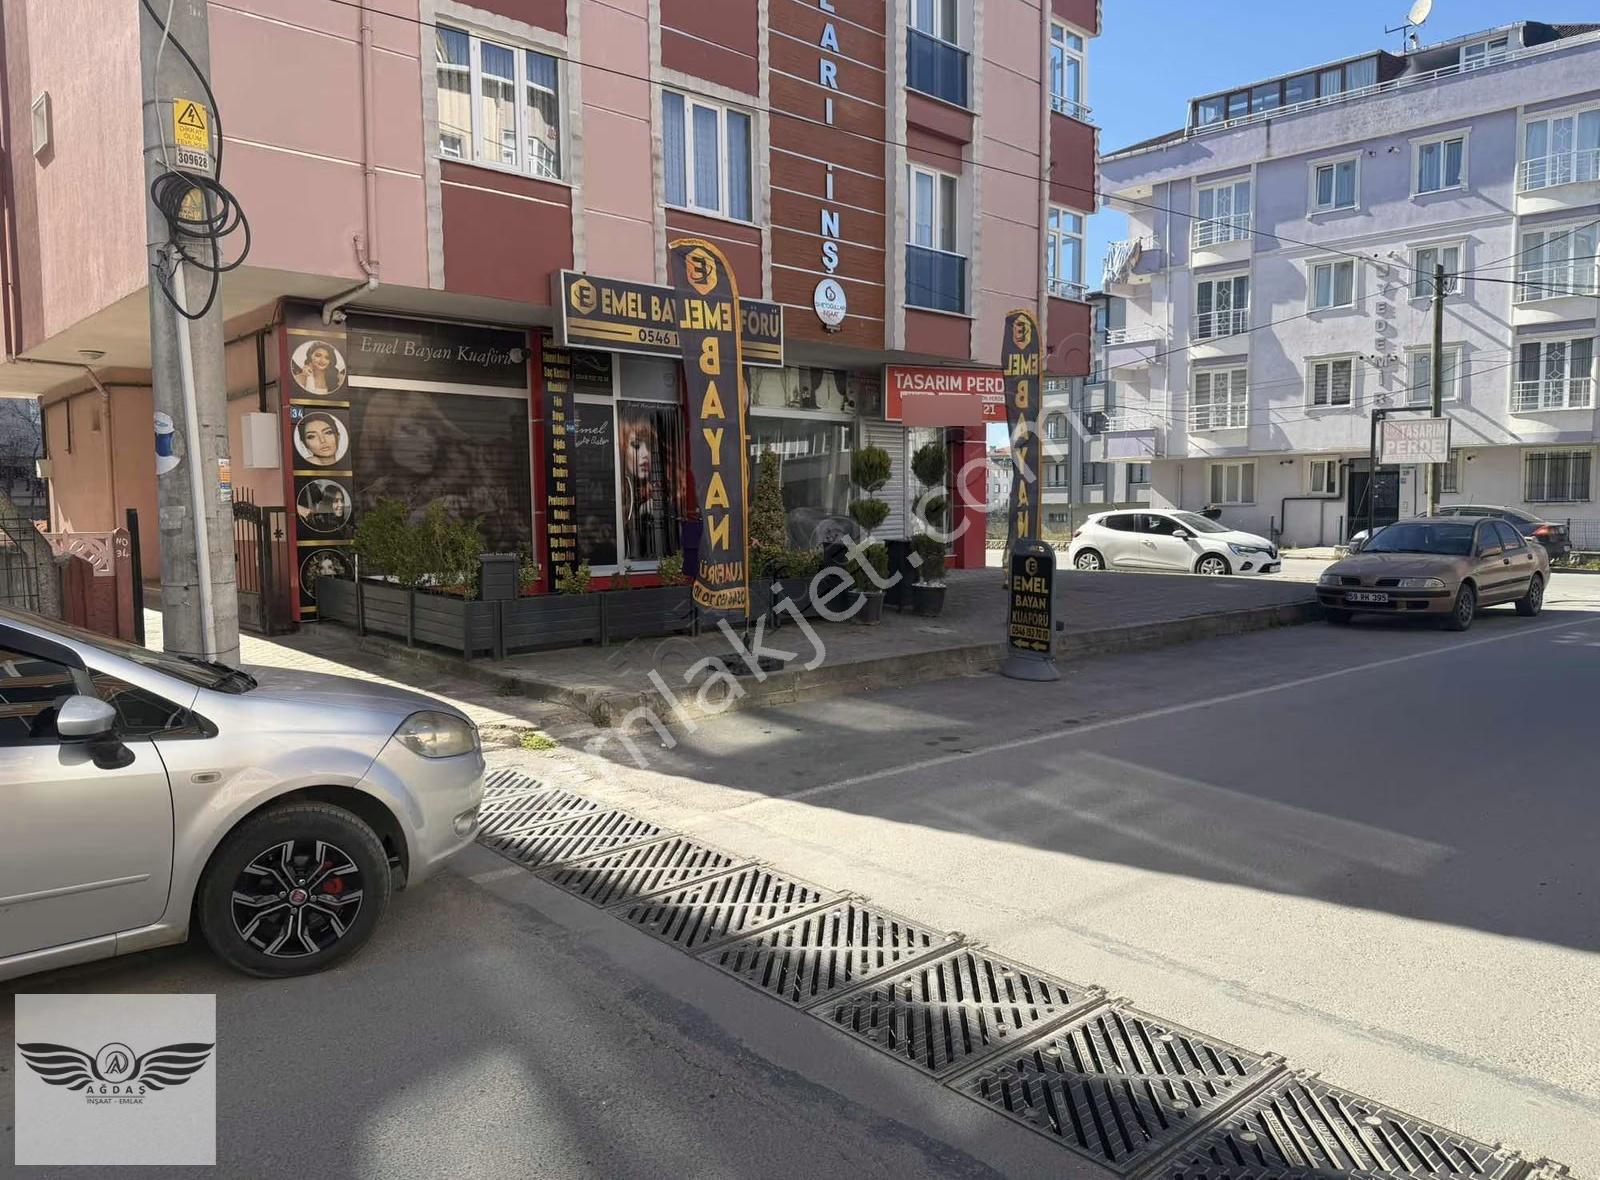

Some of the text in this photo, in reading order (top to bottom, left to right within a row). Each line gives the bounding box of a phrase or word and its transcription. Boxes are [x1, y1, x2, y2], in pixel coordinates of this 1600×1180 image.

[178, 152, 208, 168] 309628
[602, 288, 647, 320] EMEL
[651, 295, 676, 324] BA
[638, 328, 671, 345] 0546
[360, 336, 399, 355] Emel
[404, 341, 451, 362] Bayan
[894, 372, 1005, 393] TASARIM PERD
[983, 404, 997, 415] 21
[1385, 440, 1445, 454] PERDE
[1013, 575, 1049, 594] EMEL
[1015, 595, 1047, 609] BAYAN
